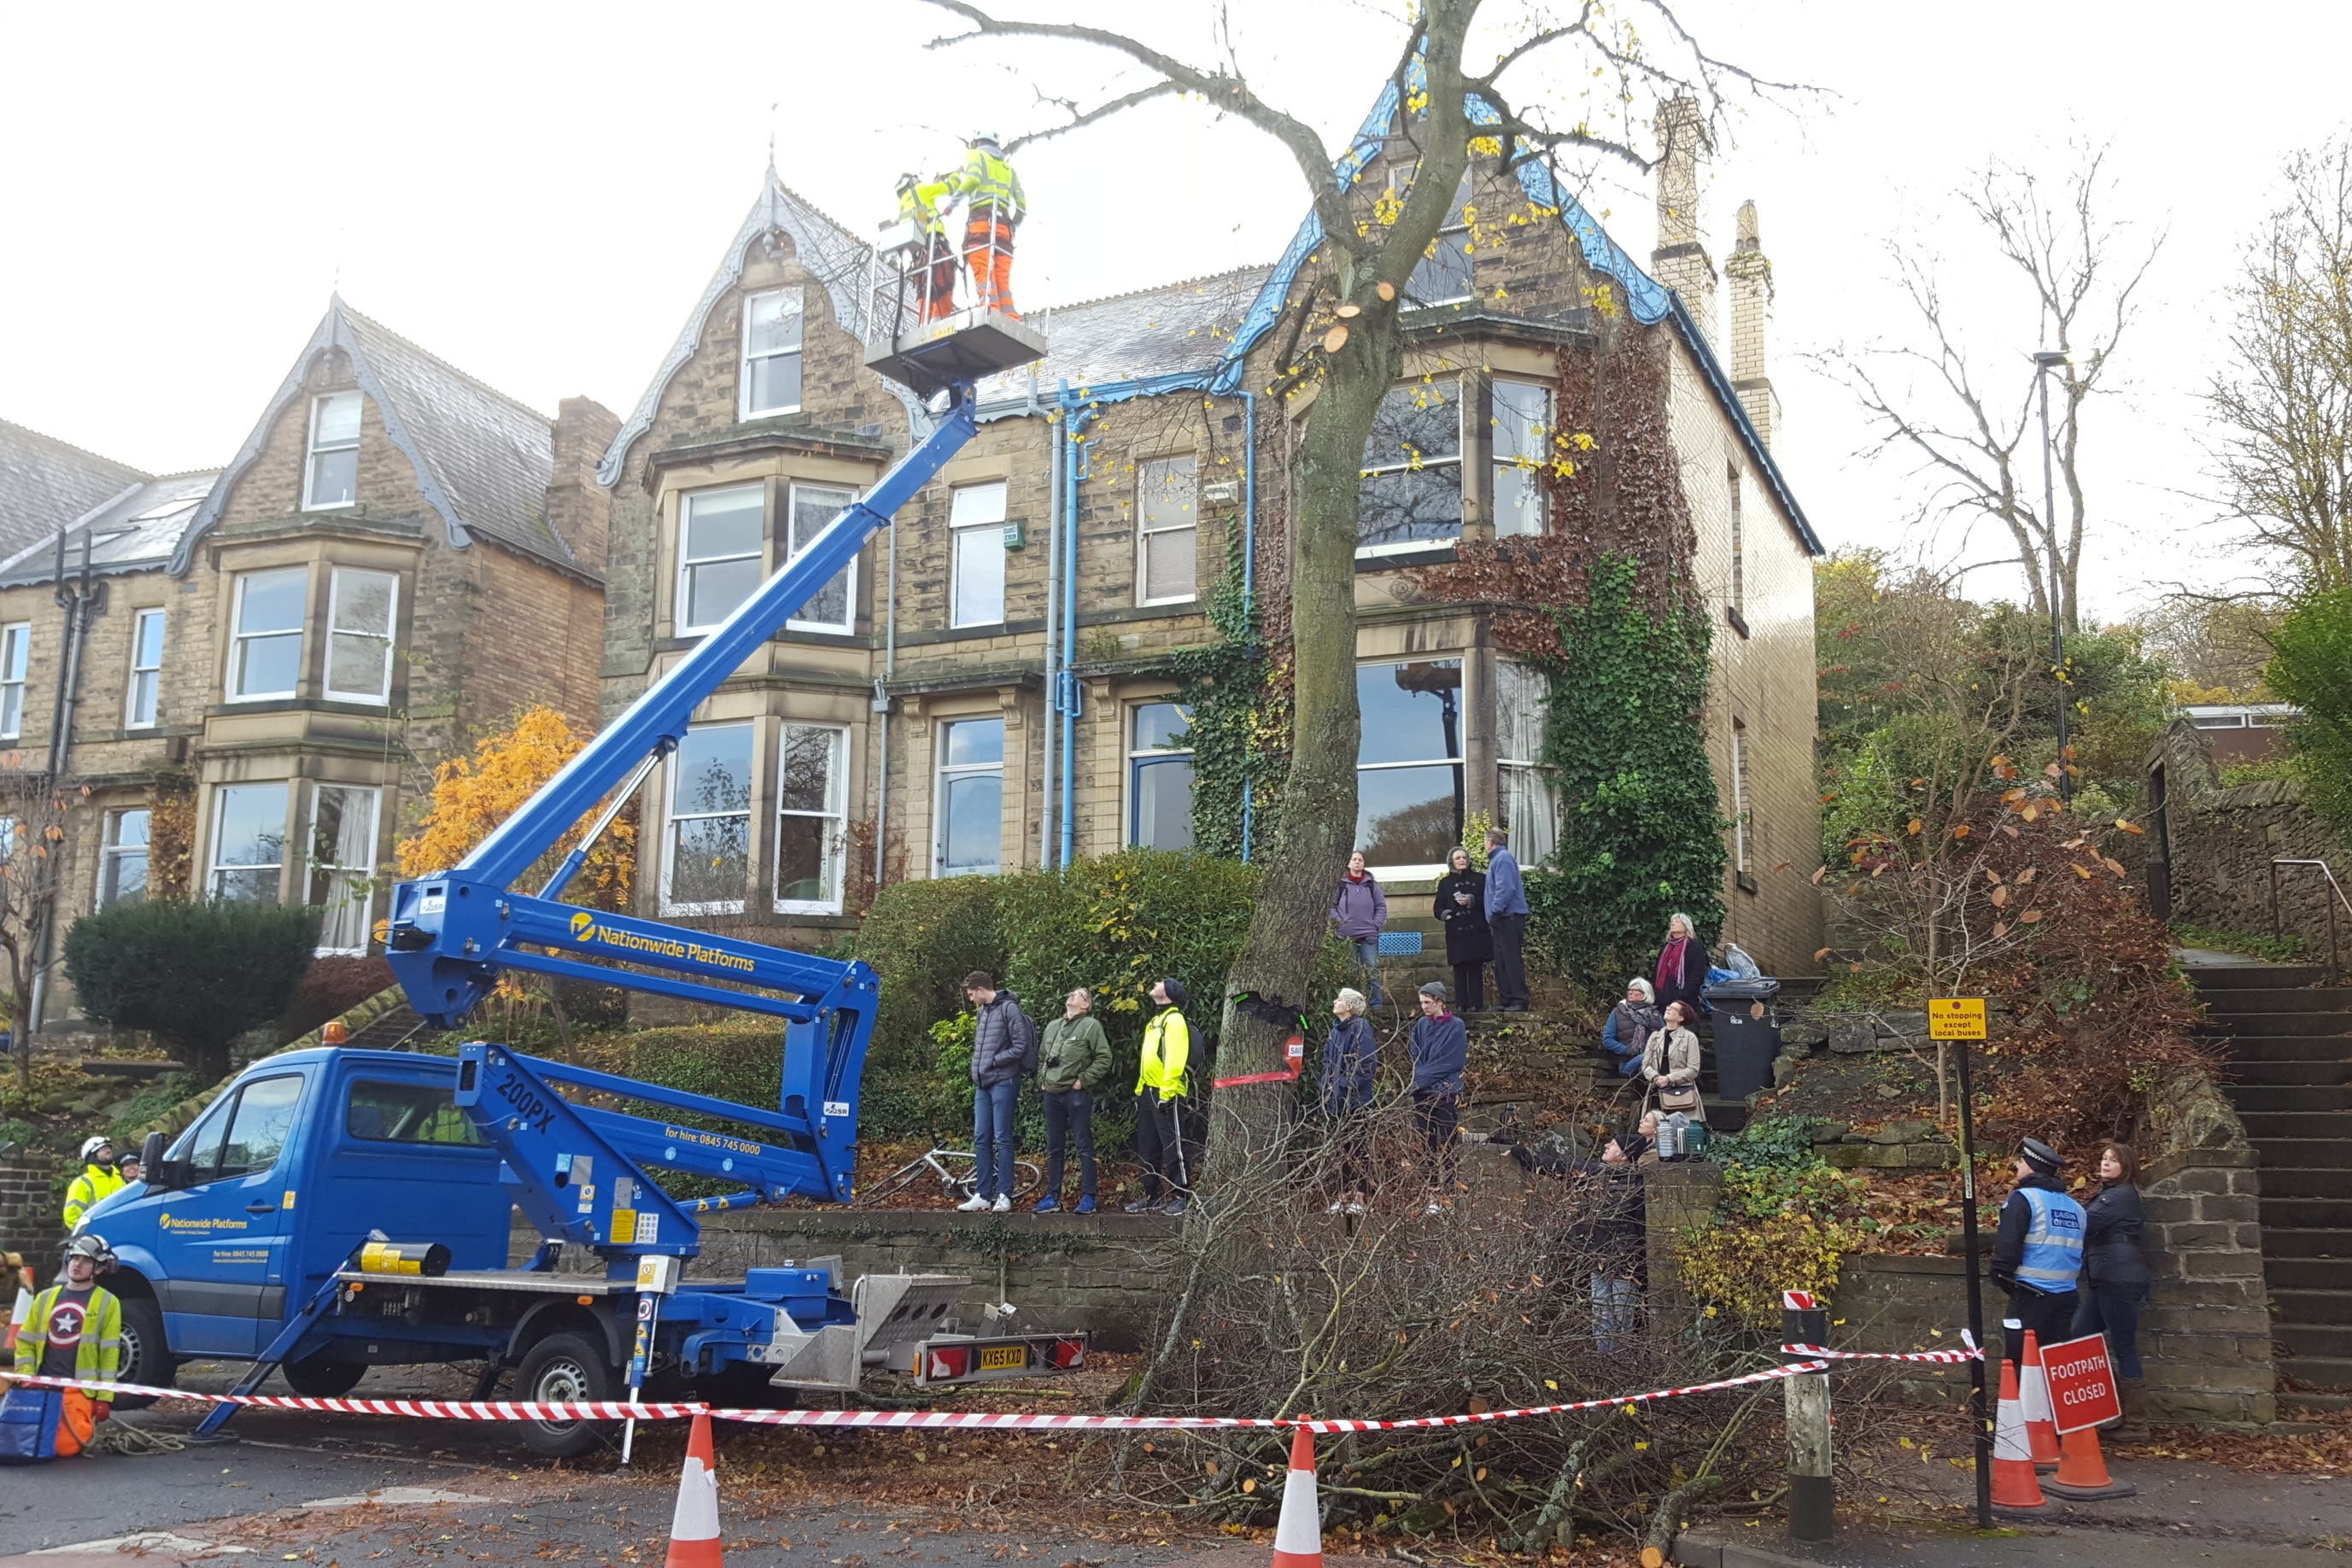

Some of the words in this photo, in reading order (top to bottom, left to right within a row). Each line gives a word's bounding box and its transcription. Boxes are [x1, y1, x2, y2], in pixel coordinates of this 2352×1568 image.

[598, 925, 685, 958] Nationwide
[687, 943, 755, 972] Platforms
[496, 1073, 556, 1134] 200PX
[665, 1126, 679, 1138] for
[679, 1128, 698, 1143] hire:
[699, 1134, 721, 1148] 0845
[723, 1138, 739, 1151] 745
[740, 1142, 761, 1155] 0000
[172, 1218, 212, 1228] Nationwide
[212, 1218, 248, 1229] Platforms
[982, 1349, 1005, 1366] KX65
[1006, 1349, 1022, 1365] KXD
[2050, 1355, 2106, 1381] FOOTPATH
[2063, 1382, 2106, 1406] CLOSED
